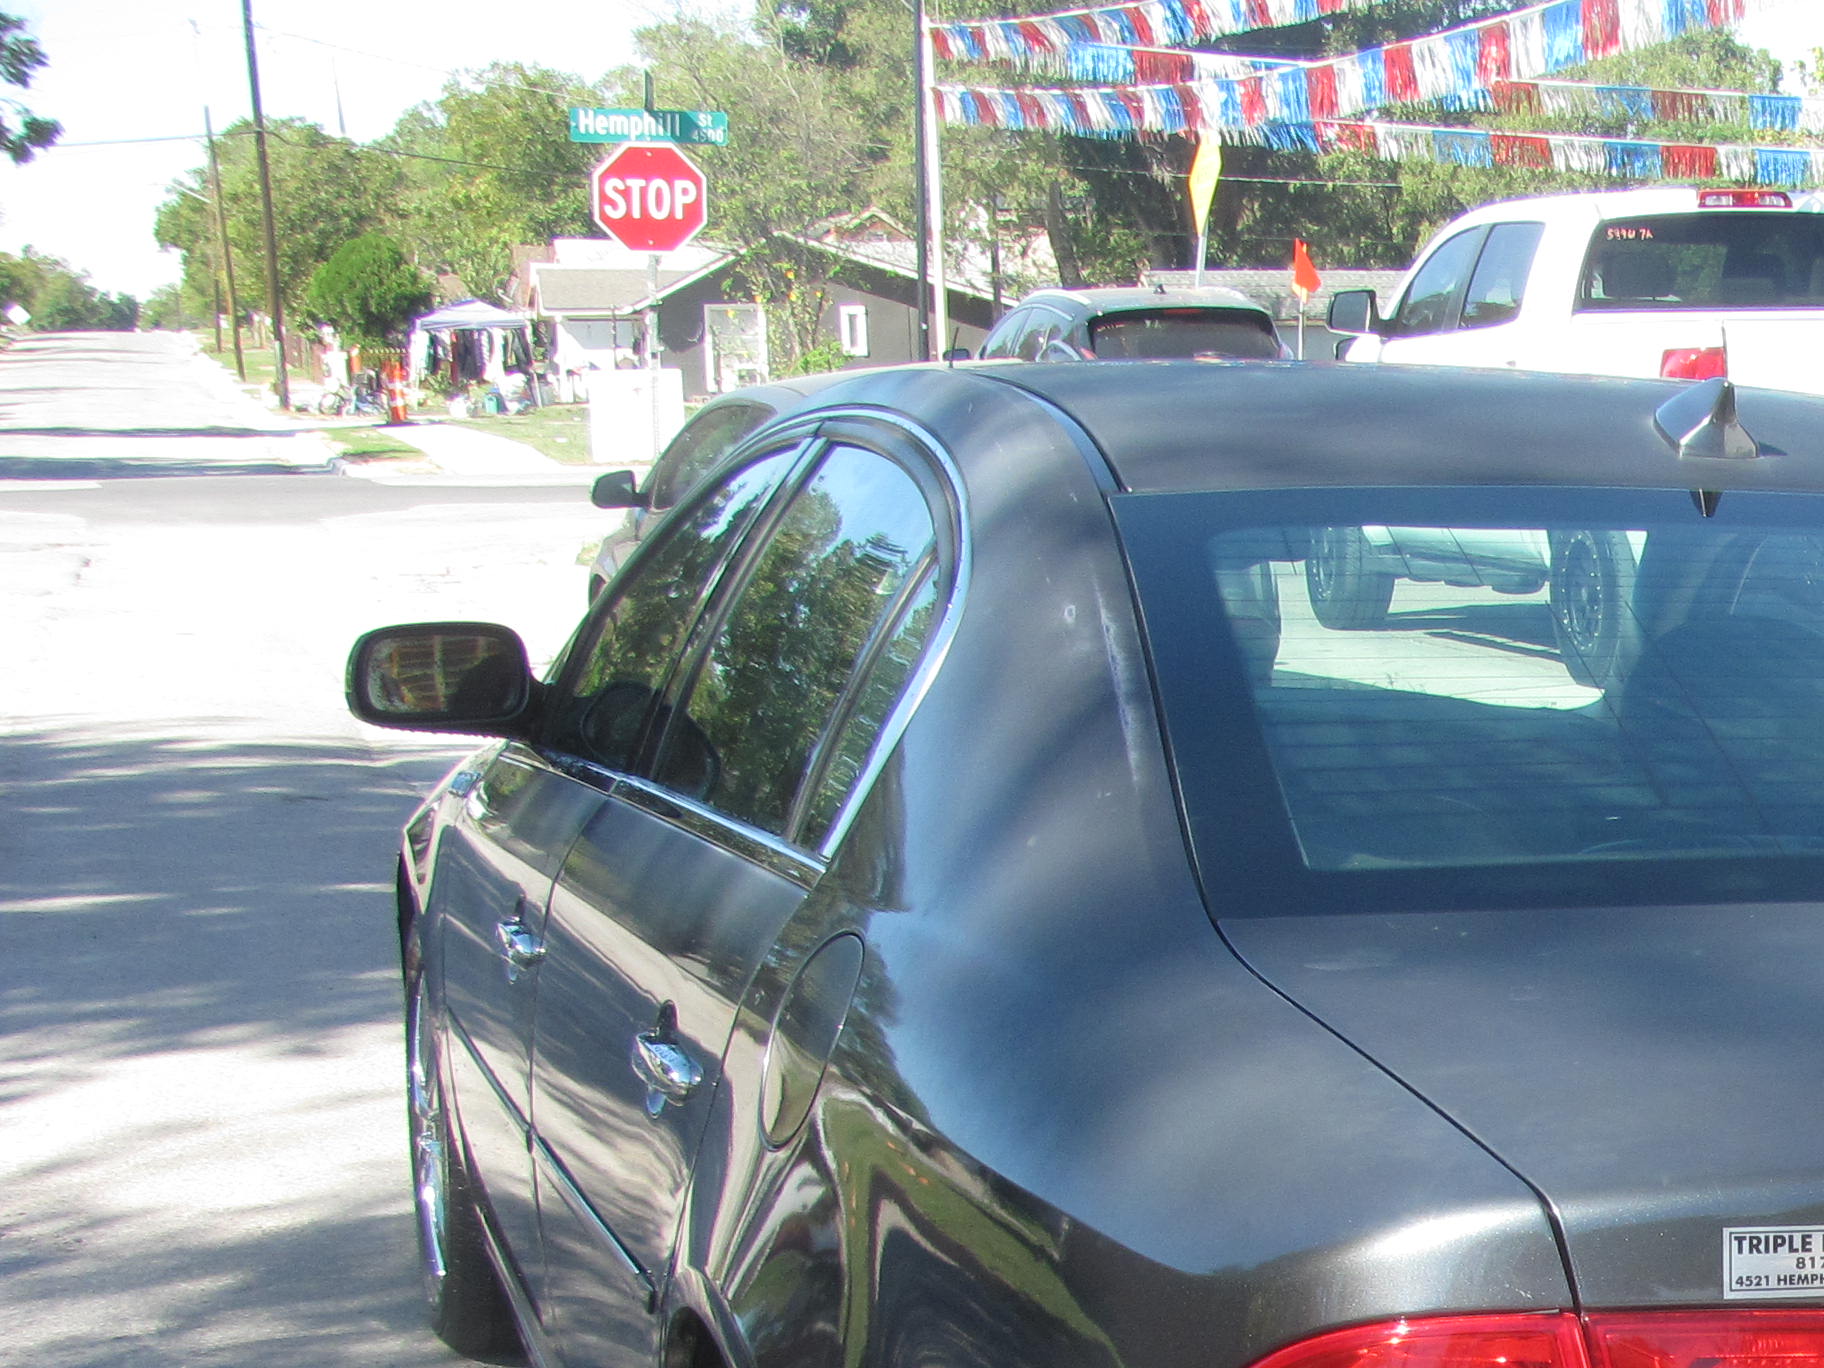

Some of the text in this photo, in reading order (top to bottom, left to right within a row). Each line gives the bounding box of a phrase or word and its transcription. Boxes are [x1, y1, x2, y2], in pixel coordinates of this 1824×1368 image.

[578, 109, 713, 141] Hemphill St
[603, 178, 697, 220] STOP
[1733, 1234, 1812, 1255] TRIPLE
[1735, 1275, 1770, 1288] 4521
